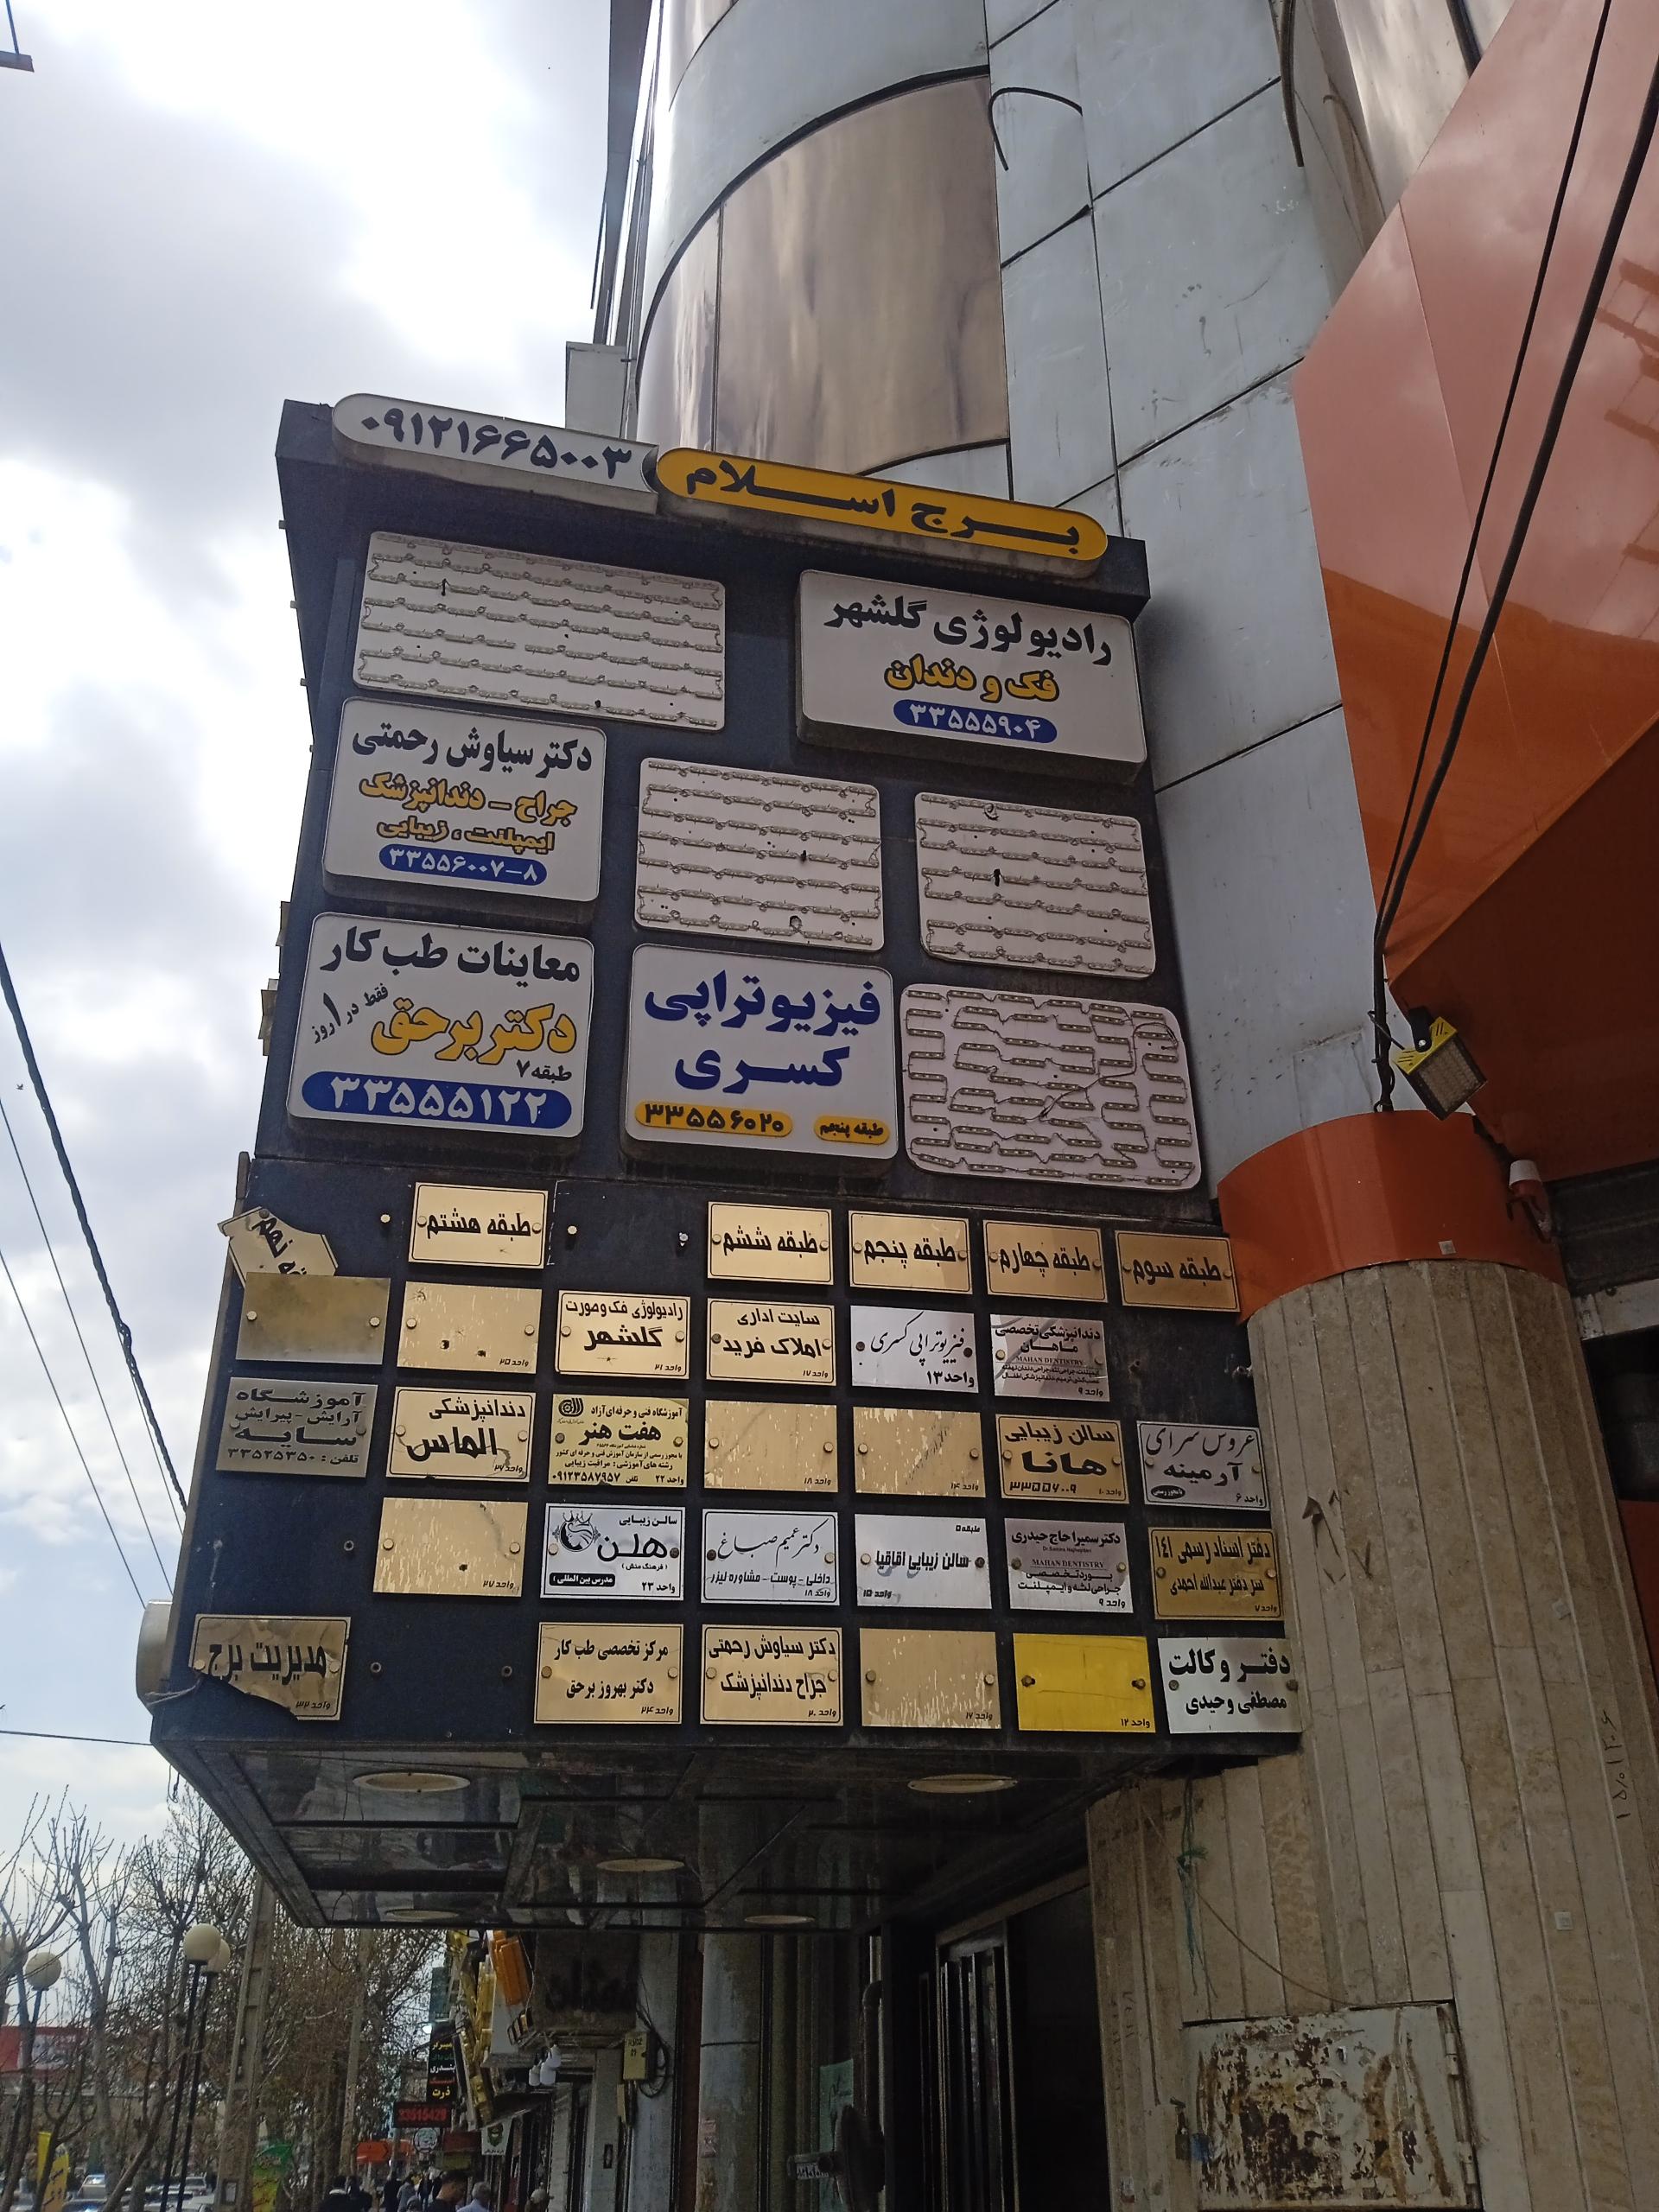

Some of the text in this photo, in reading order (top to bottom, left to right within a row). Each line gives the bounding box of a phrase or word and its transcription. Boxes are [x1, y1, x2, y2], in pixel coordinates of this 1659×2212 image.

[361, 408, 632, 479] ۰۹۱۲۱۶۶۵۰۰۳
[687, 461, 1080, 554] برج اسلام
[823, 594, 1112, 665] رادیولوژی گلشهر
[884, 653, 1060, 702] فک و دندان
[910, 703, 1043, 739] ۳۳۵۵۵۹۰۴
[353, 723, 592, 778] دکتر سیاوش رحمتی
[359, 772, 578, 826] جراح دندانپزشک
[377, 816, 448, 842] زیبایی
[320, 925, 580, 988] معاینات طب کار
[365, 983, 389, 1007] فقط
[645, 969, 880, 1036] فیزیوتراپی
[346, 1003, 359, 1024] در
[312, 1022, 335, 1043] روز
[371, 998, 576, 1065] دکتر برحق
[517, 1060, 572, 1083] طبقه ۷
[675, 1046, 849, 1094] کسری
[330, 1077, 546, 1123] ۳۳۵۵۵۱۲۲
[645, 1103, 784, 1131] ۳۳۵۵۶۰۲۰
[820, 1123, 883, 1138] طبقه پنجم
[427, 1208, 531, 1242] طبقه هشتم
[723, 1225, 818, 1258] طبقه ششم
[864, 1236, 957, 1268] طبقه پنجم
[1000, 1243, 1090, 1277] طبقه چهارم
[1133, 1257, 1222, 1286] طبقه سوم
[566, 1300, 683, 1320] رادیولوژی فک و صورت
[737, 1308, 820, 1326] سایت اداری
[584, 1325, 663, 1351] گلشهر
[871, 1311, 964, 1366] فیزیوتراپی کسری
[995, 1324, 1100, 1340] دندانپزشکی تخصصی
[723, 1337, 822, 1358] املاک فرید
[1020, 1339, 1077, 1352] ماهان
[927, 1370, 975, 1387] واحد ۱۳
[236, 1388, 366, 1410] آموزشگاه
[429, 1397, 525, 1422] دندانپزشکی
[235, 1407, 362, 1426] آرایش پیرایش
[591, 1405, 683, 1420] آموزشگاه فنی و حرفه ای آزاد
[234, 1427, 357, 1448] سایه
[406, 1427, 498, 1462] الماس
[578, 1421, 661, 1446] هفت هنر
[1005, 1421, 1115, 1446] سالن زیبایی
[1146, 1427, 1255, 1458] عروس سرای
[330, 1454, 359, 1465] تلفن
[1022, 1451, 1107, 1476] هانا
[552, 1471, 620, 1482] ۰۹۱۲۳۵۸۷۹۵۷
[667, 1476, 683, 1484] واحد
[620, 1515, 677, 1526] سالن زیبایی
[962, 1525, 980, 1534] طبقه
[597, 1534, 667, 1561] هلن
[718, 1532, 778, 1559] صباغ
[791, 1518, 829, 1559] دکتر
[1012, 1531, 1121, 1547] دکتر سمیرا حاج حیدری
[1214, 1535, 1243, 1558] اسناد
[1248, 1538, 1270, 1564] دفتر
[876, 1551, 969, 1571] سالن زیبایی اقاقیا
[1179, 1541, 1211, 1564] رسمی
[557, 1573, 613, 1586] مدرس بین المللی
[642, 1582, 675, 1592] واحد ۲۳
[710, 1570, 830, 1588] داخلی پوست مشاوره لیزر
[1170, 1573, 1264, 1596] سر دفتر عبدالله احمدی
[554, 1639, 668, 1661] مرکز تخصصی طب کار
[709, 1635, 836, 1660] دکتر سیاوش رحمتی
[207, 1643, 327, 1685] مدیریت برج
[1169, 1647, 1291, 1682] دفتر وکالت
[567, 1677, 654, 1699] دکتر بهروز برحق
[721, 1671, 826, 1700] جراح دندانپزشک
[1185, 1690, 1287, 1714] مصطفی وحیدی
